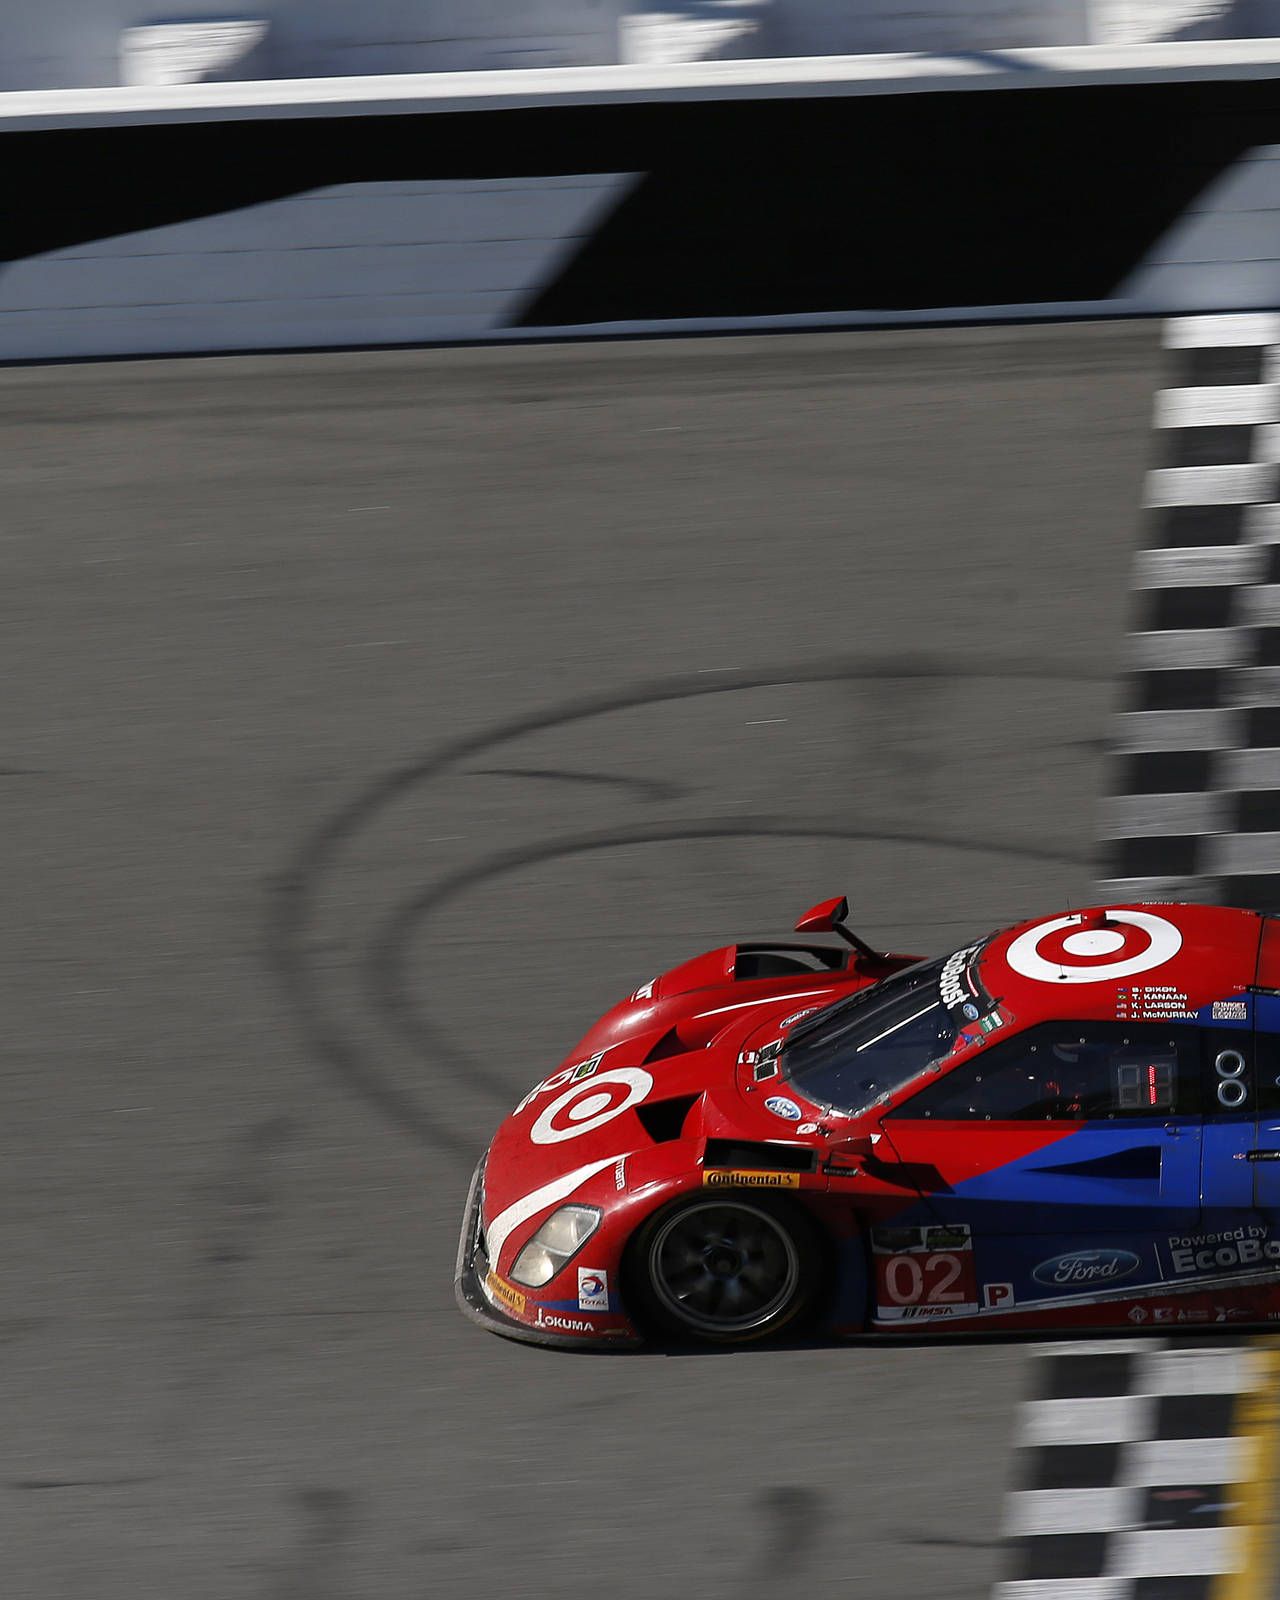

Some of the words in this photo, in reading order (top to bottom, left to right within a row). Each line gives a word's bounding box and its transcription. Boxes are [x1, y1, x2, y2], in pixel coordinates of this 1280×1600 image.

[1143, 993, 1188, 1001] KANAAN
[1130, 1011, 1141, 1019] J.
[1142, 1011, 1199, 1019] McMURRAY
[707, 1172, 782, 1185] Continental
[1168, 1230, 1245, 1249] Powered
[1248, 1226, 1268, 1240] by
[1054, 1254, 1121, 1283] Ford
[885, 1254, 965, 1304] 02
[579, 1298, 607, 1306] TOTAL
[988, 1286, 1009, 1306] P
[917, 1306, 954, 1316] IMSA
[545, 1316, 595, 1332] OKUMA
